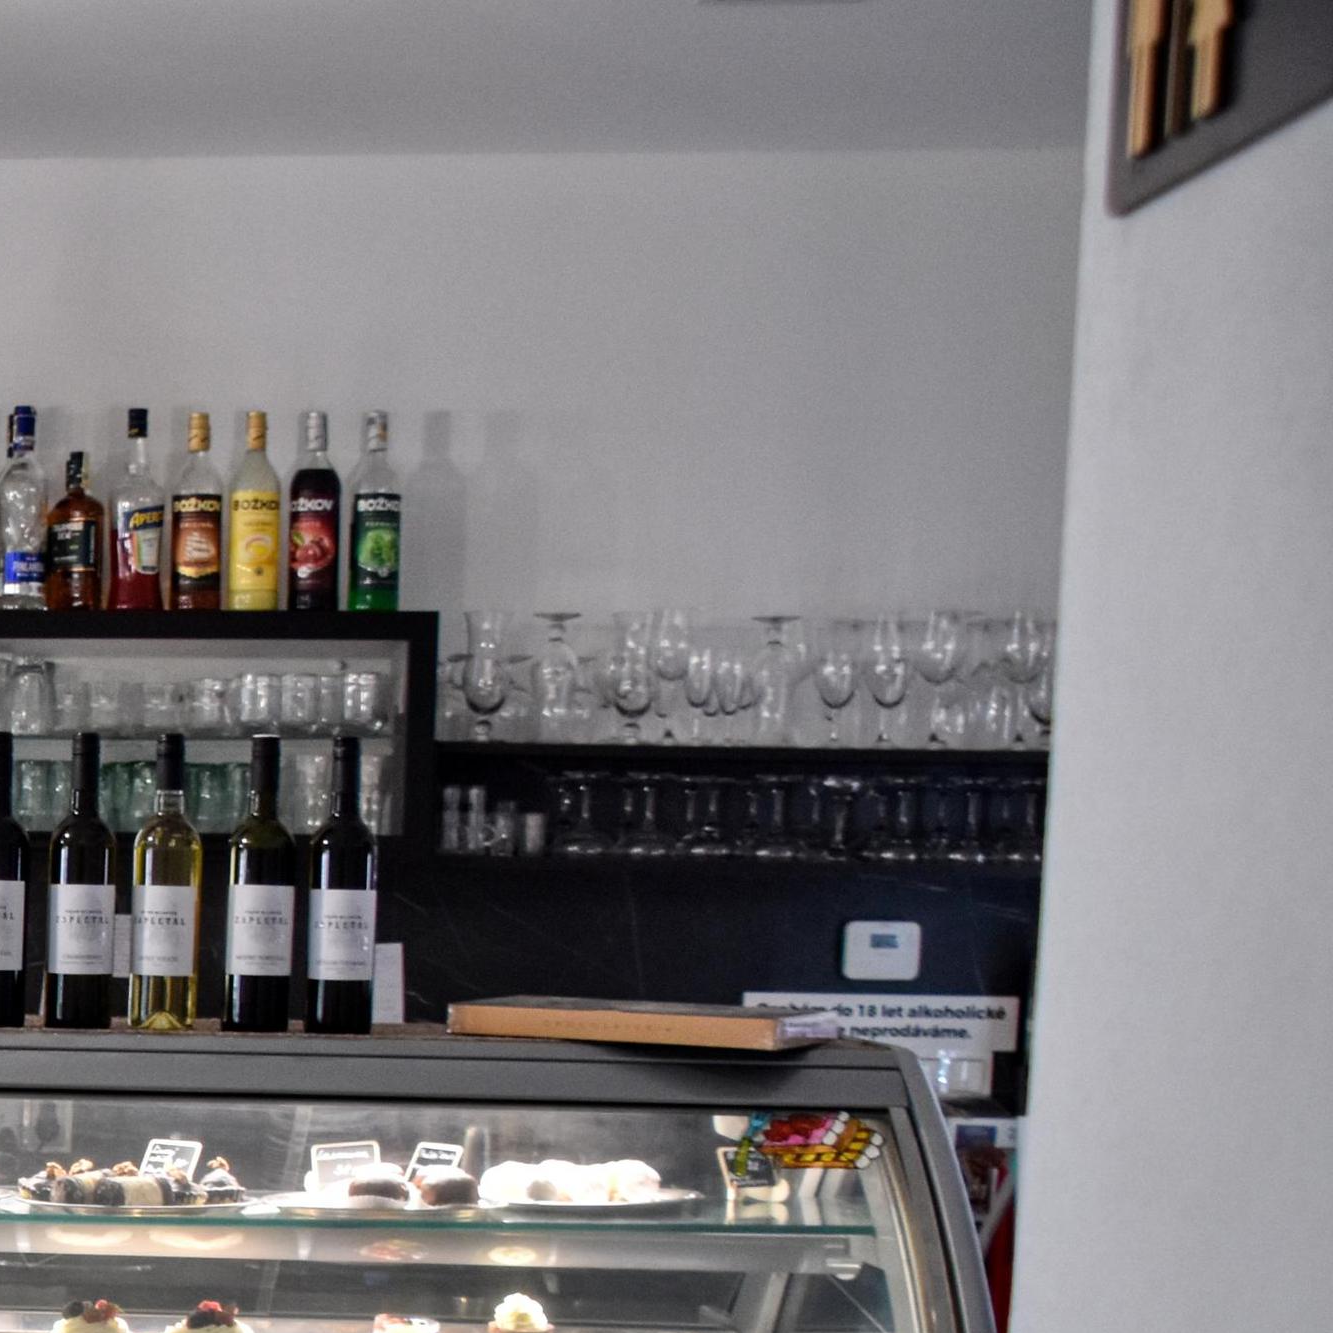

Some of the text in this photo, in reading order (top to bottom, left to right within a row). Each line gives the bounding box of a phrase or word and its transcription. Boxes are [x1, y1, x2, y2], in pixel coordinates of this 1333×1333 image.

[858, 1004, 877, 1018] 18
[882, 1004, 904, 1019] let
[907, 1005, 1007, 1021] alkoholické
[849, 1022, 972, 1040] neprodáváme.
